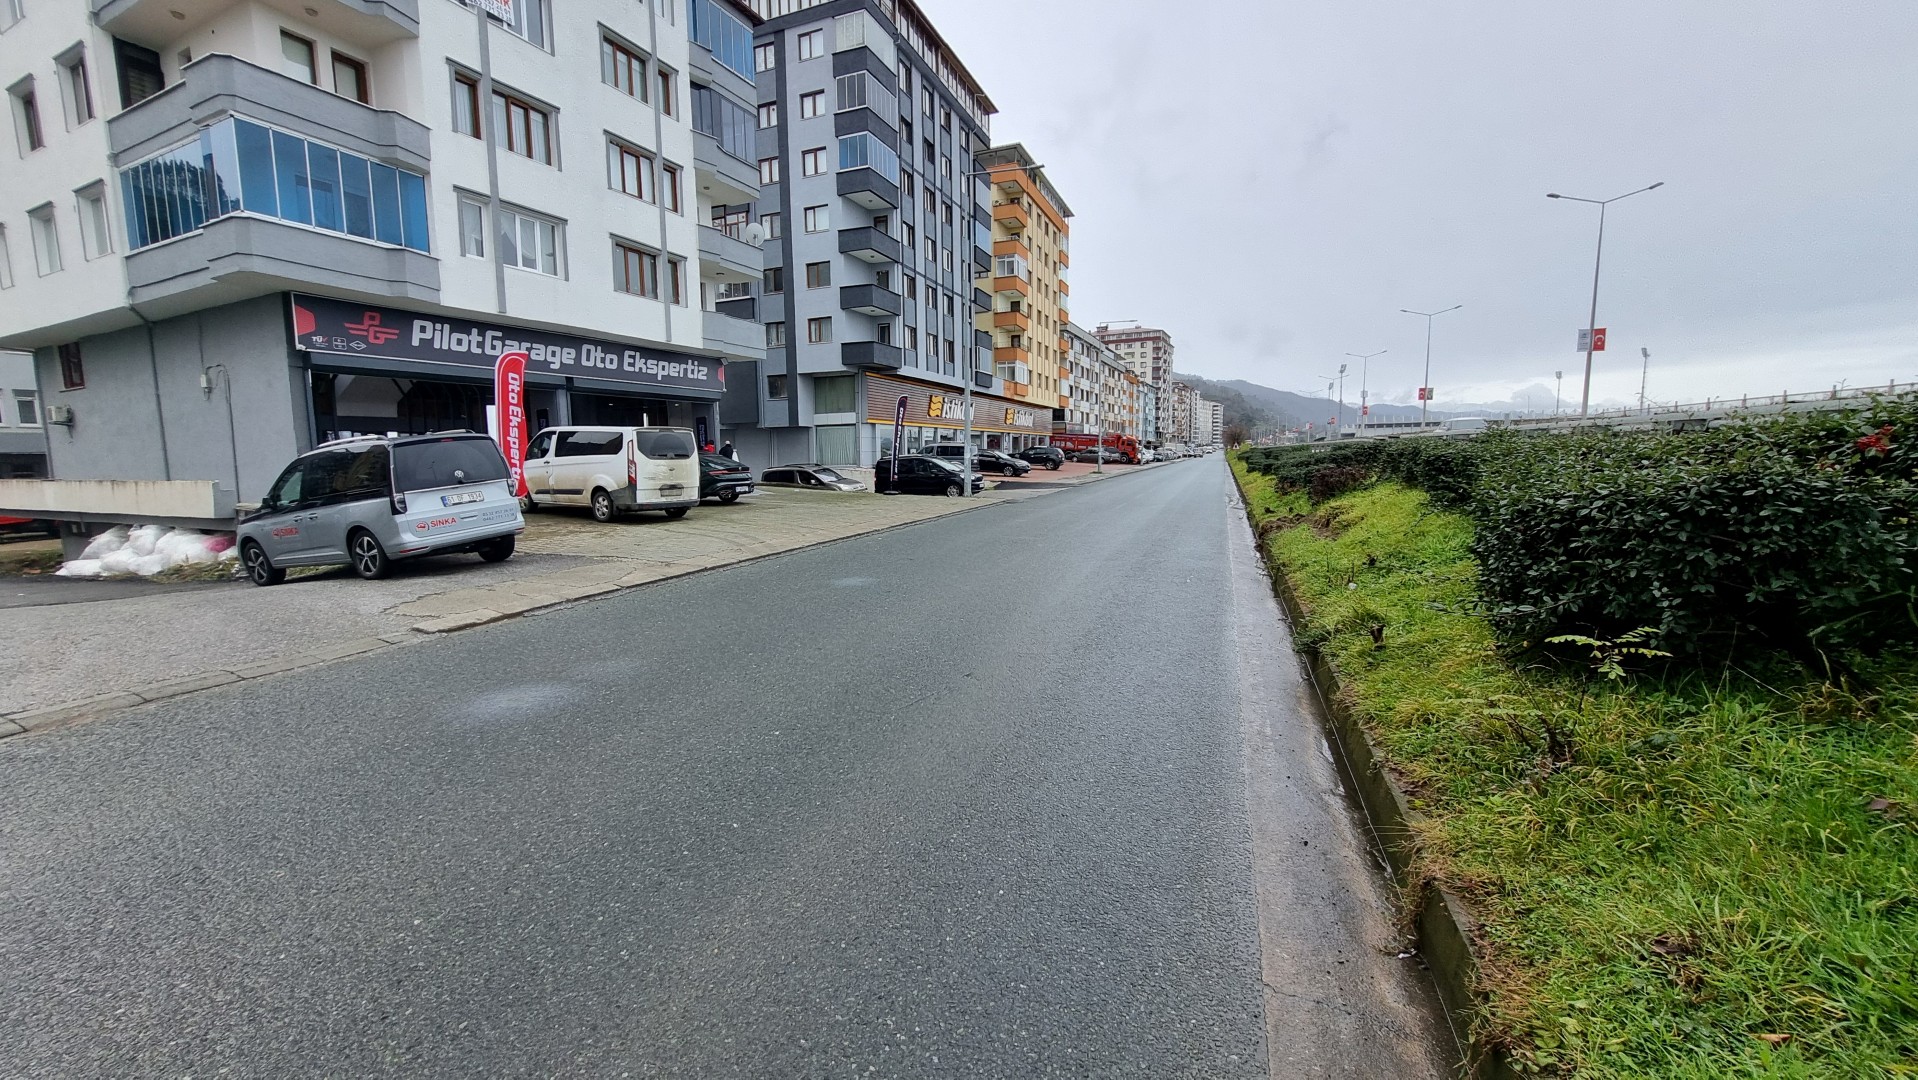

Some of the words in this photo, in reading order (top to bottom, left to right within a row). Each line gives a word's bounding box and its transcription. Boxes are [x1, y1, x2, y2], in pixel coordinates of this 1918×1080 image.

[411, 319, 577, 370] PilotGarage
[581, 343, 619, 370] Oto
[623, 350, 708, 381] Ekspertiz
[508, 372, 521, 404] Oto
[430, 517, 457, 528] SINKA
